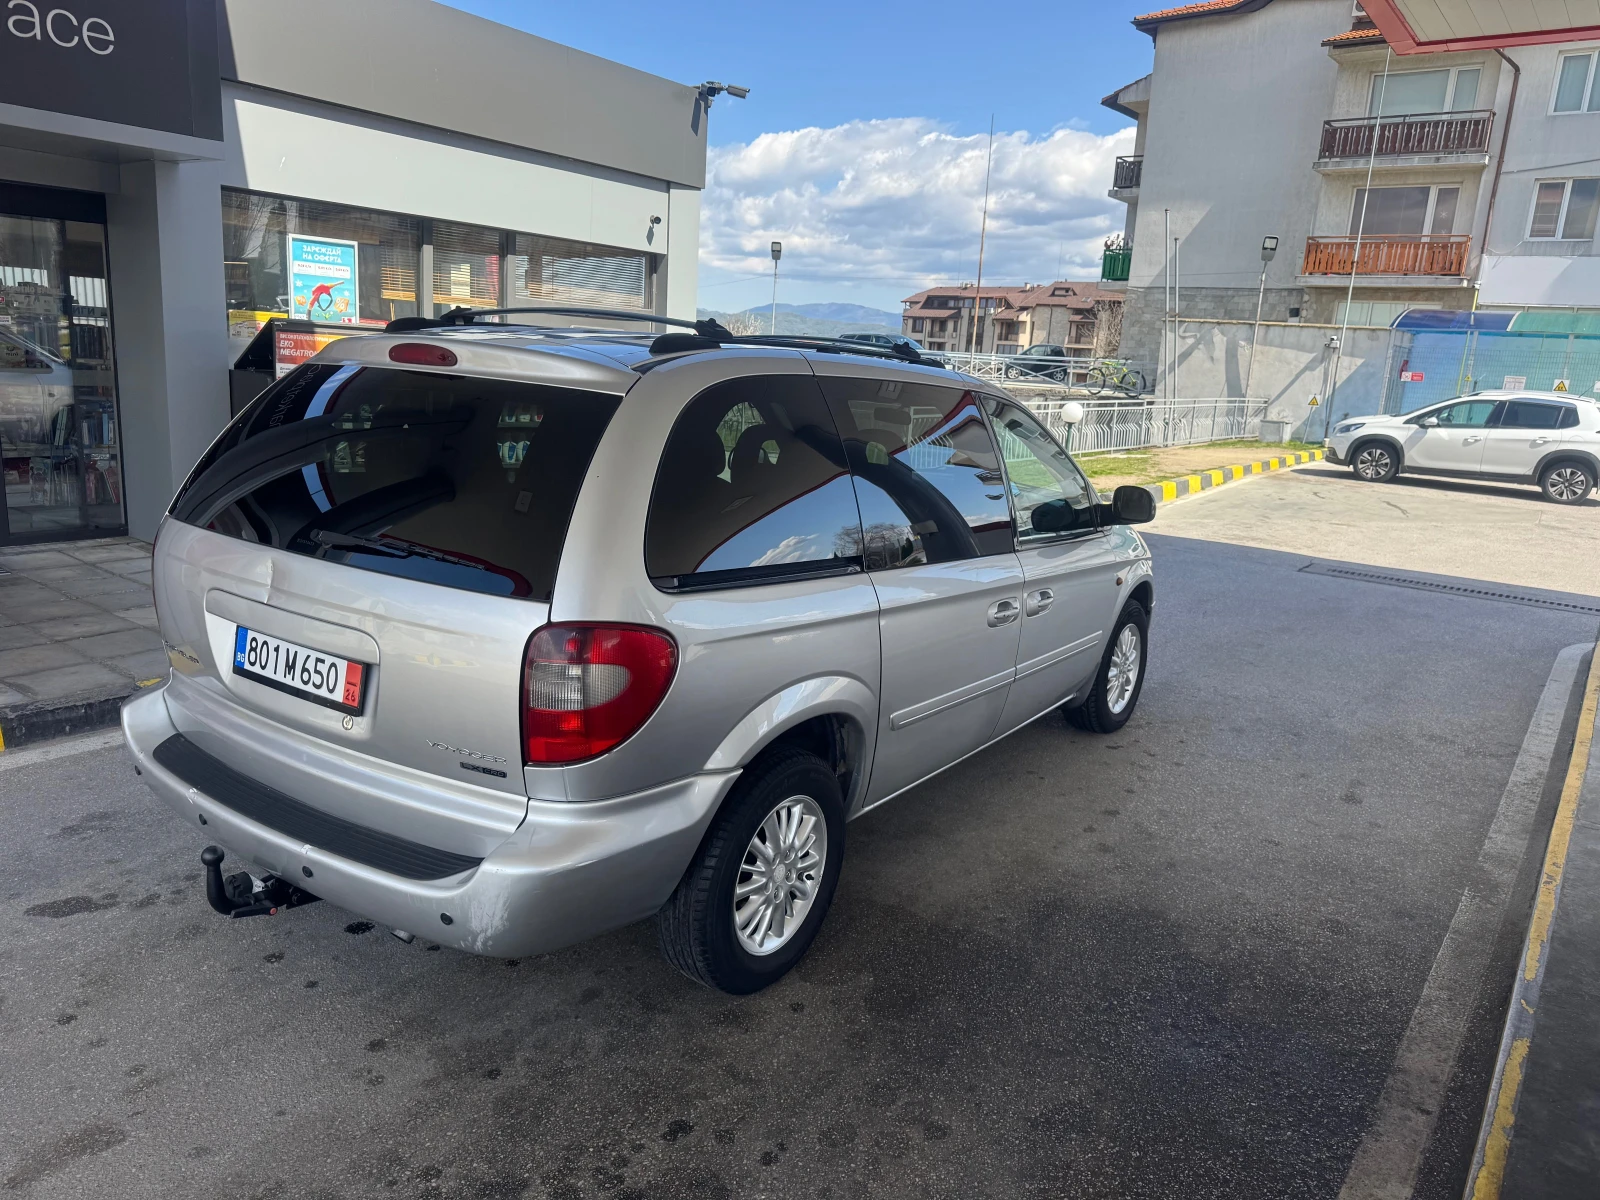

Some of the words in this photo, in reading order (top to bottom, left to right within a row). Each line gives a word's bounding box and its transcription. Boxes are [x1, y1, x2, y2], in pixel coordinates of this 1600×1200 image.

[7, 0, 115, 55] ace
[302, 245, 342, 255] ЗАРЕЖДАЙ
[314, 254, 342, 263] ОФЕРТА
[237, 652, 245, 662] BG
[248, 636, 339, 694] 801M650
[345, 689, 356, 702] 26
[426, 739, 507, 765] VOYAGER
